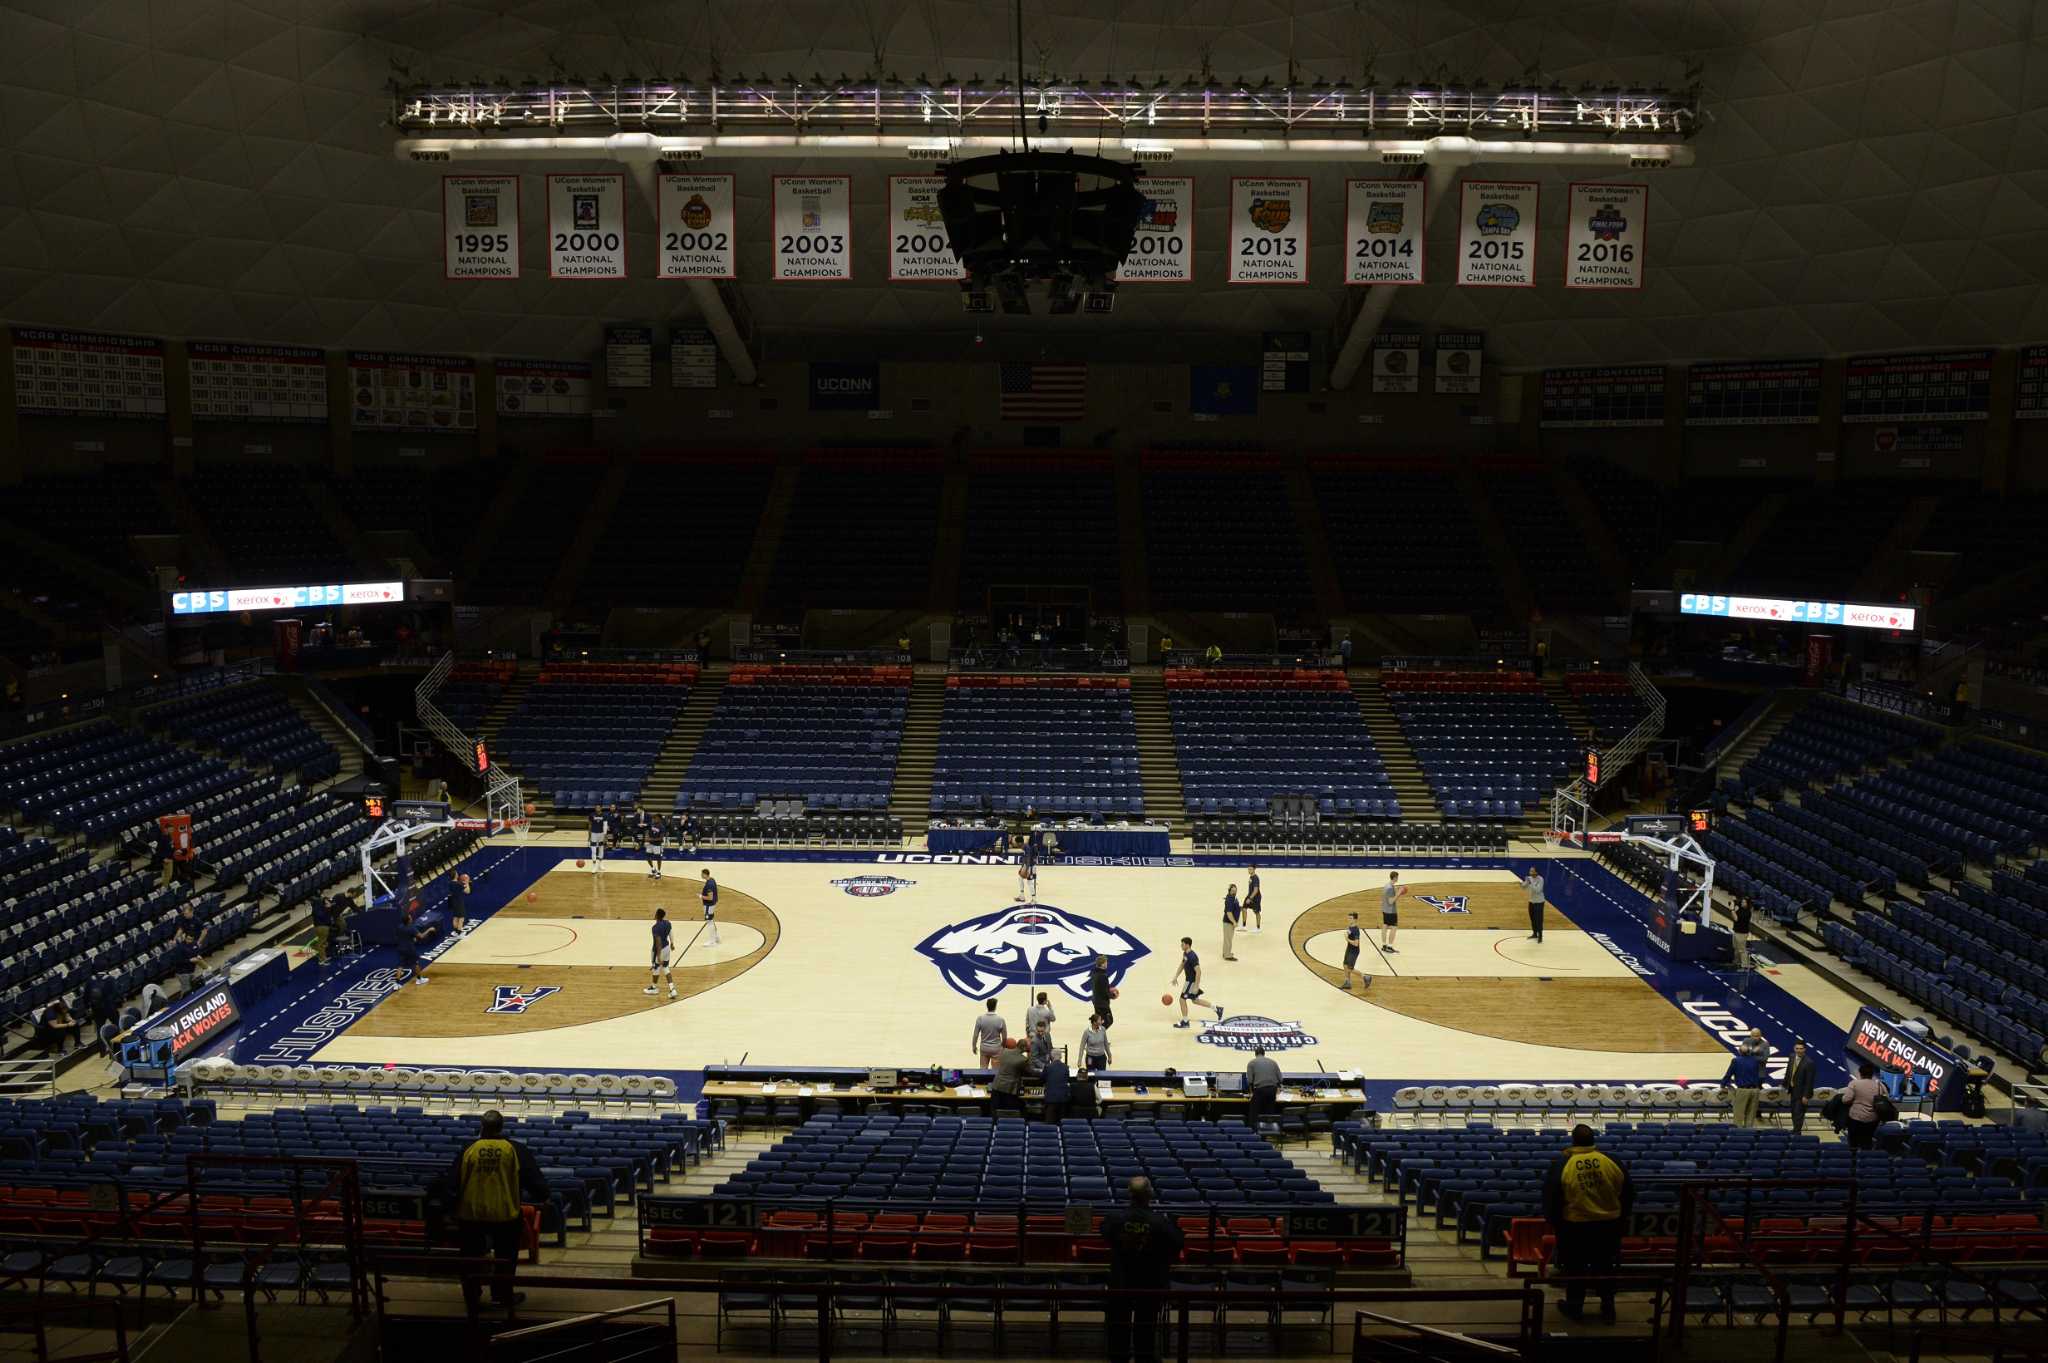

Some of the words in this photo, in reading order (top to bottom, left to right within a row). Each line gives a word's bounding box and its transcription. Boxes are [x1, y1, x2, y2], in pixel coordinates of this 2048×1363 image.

[566, 185, 605, 193] Basketball
[1251, 189, 1290, 197] Basketball
[1606, 187, 1640, 195] Women's
[1588, 195, 1628, 203] Basketball
[455, 234, 508, 252] 1995
[555, 233, 619, 251] 2000
[665, 232, 728, 251] 2002
[781, 235, 843, 253] 2003
[1241, 237, 1297, 256] 2013
[1356, 238, 1414, 257] 2014
[1469, 240, 1524, 259] 2015
[1577, 243, 1634, 262] 2016
[458, 256, 506, 264] NATIONAL
[562, 255, 612, 263] NATIONAL
[787, 257, 838, 265] NATIONAL
[903, 256, 954, 265] NATIONAL
[1128, 258, 1179, 266] NATIONAL
[1243, 259, 1294, 268] NATIONAL
[668, 266, 726, 274] CHAMPIONS
[1358, 261, 1410, 269] NATIONAL
[1471, 263, 1522, 271] NATIONAL
[1579, 265, 1630, 274] NATIONAL
[455, 267, 511, 275] CHAMPIONS
[559, 266, 617, 275] CHAMPIONS
[783, 269, 842, 277] CHAMPIONS
[899, 268, 959, 276] CHAMPIONS
[1123, 270, 1184, 278] CHAMPIONS
[1238, 271, 1298, 279] CHAMPIONS
[1354, 272, 1415, 281] CHAMPIONS
[1466, 274, 1526, 283] CHAMPIONS
[1574, 276, 1633, 286] CHAMPIONS
[816, 377, 873, 391] UCONN
[173, 590, 226, 611] CBS
[237, 595, 270, 606] xerox
[294, 585, 342, 604] CBS
[350, 590, 379, 600] xerox
[1681, 594, 1728, 612] CBS
[1736, 604, 1767, 614] xerox
[1792, 601, 1841, 621] CBS
[1851, 611, 1884, 623] xerox
[369, 806, 383, 816] 30
[1695, 820, 1706, 830] 30
[877, 854, 1015, 865] UCONN
[1647, 929, 1670, 953] TRAVELERS
[1588, 931, 1631, 955] Alumni
[1618, 955, 1656, 975] Court
[180, 992, 227, 1030] ENGLAND
[254, 967, 413, 1061] HUSKIES
[172, 1030, 194, 1054] ACK
[192, 1003, 232, 1037] WOLVES
[1199, 1034, 1316, 1045] CHAMPIONS
[1856, 1032, 1892, 1062] BLACK
[1861, 1020, 1889, 1043] NEW
[1888, 1037, 1944, 1079] ENGLAND
[479, 1147, 503, 1158] CSC
[1575, 1158, 1601, 1170] CSC
[366, 1200, 401, 1214] SEC
[649, 1206, 684, 1220] SEC
[703, 1202, 753, 1225] 121
[1292, 1217, 1329, 1230] SEC
[1347, 1212, 1397, 1235] 121
